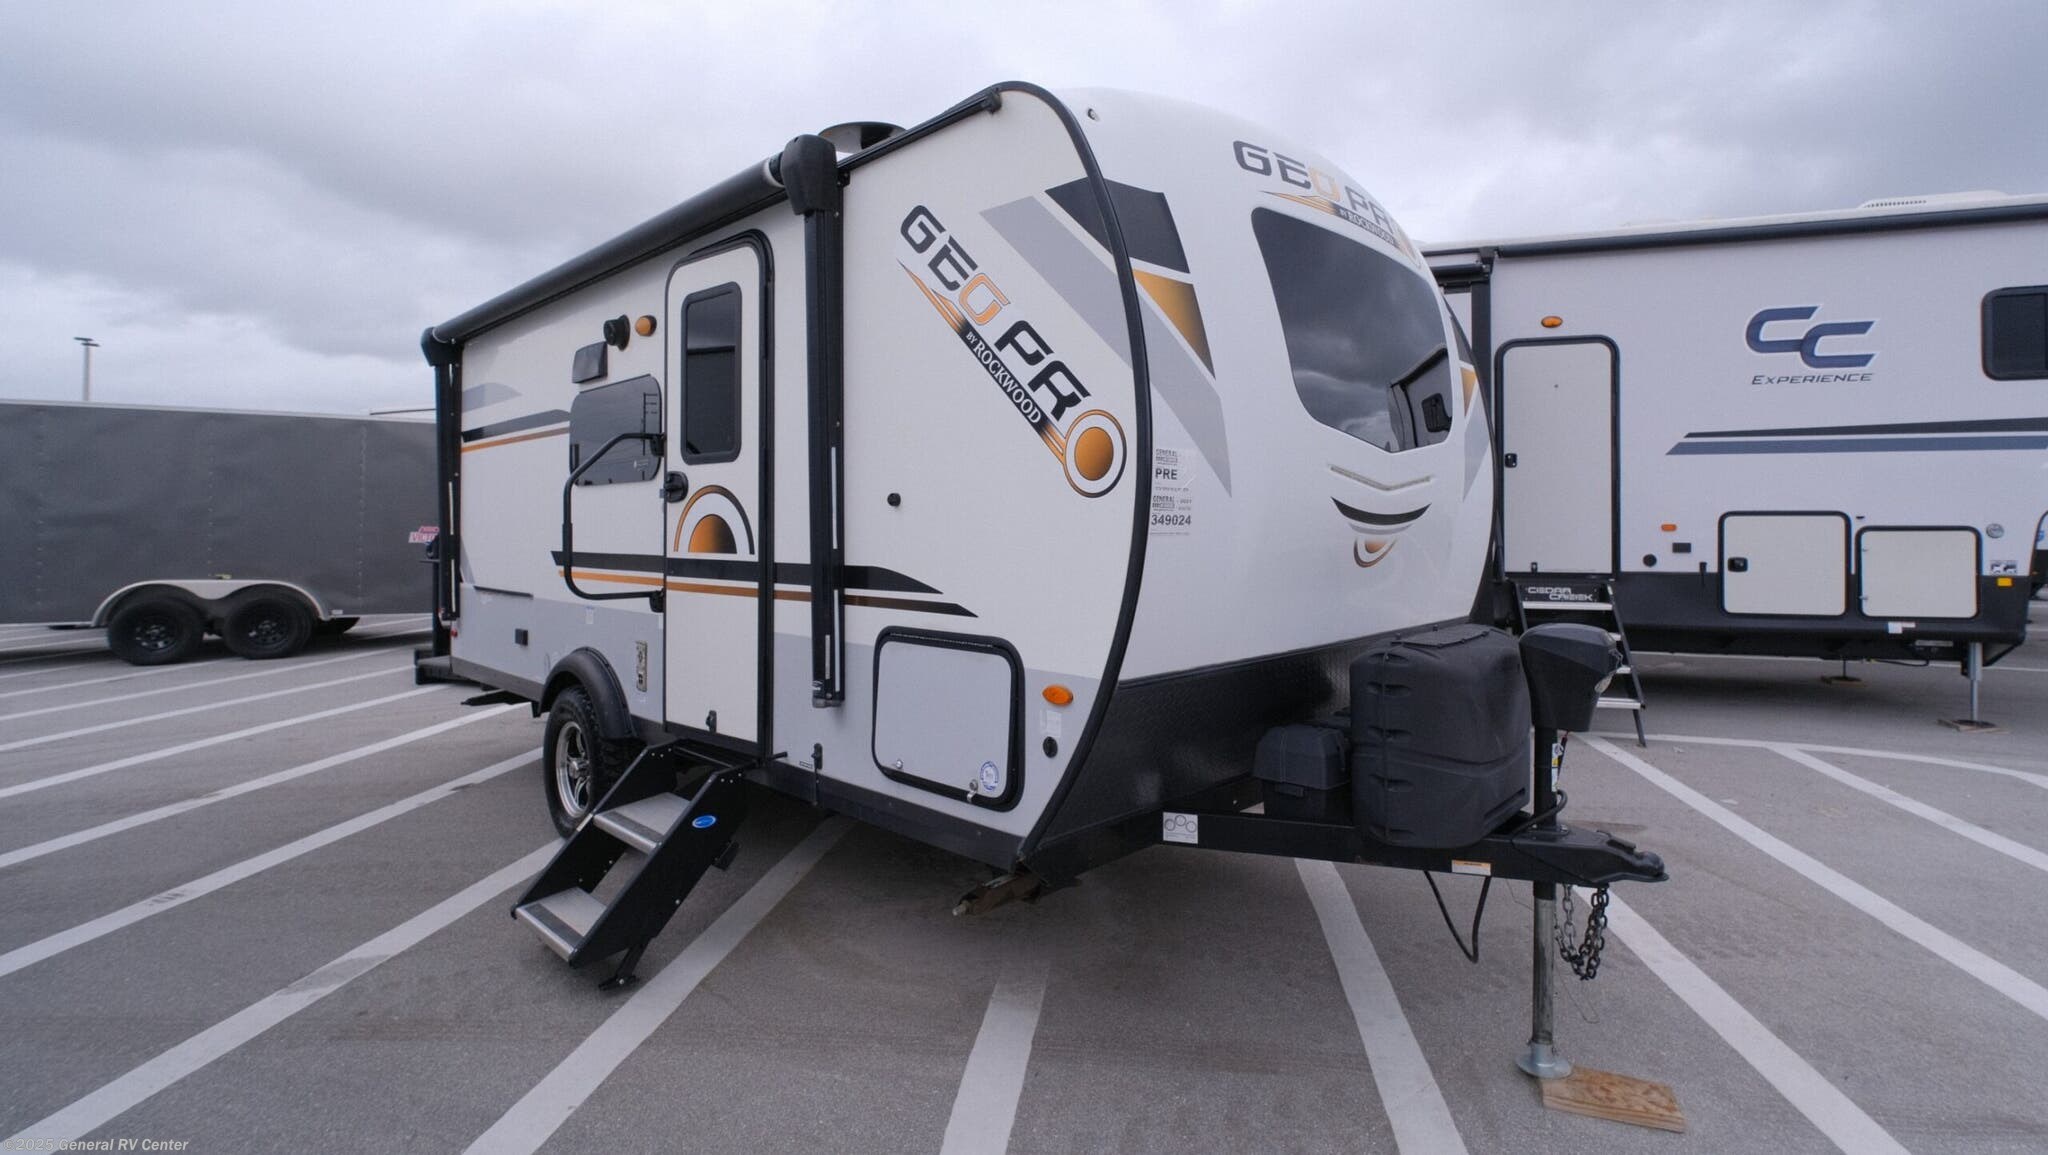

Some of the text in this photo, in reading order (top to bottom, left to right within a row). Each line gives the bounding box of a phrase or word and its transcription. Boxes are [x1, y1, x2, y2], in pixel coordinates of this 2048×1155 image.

[1233, 140, 1341, 202] GEO
[900, 204, 1011, 325] GEO
[1745, 305, 1876, 369] CC
[965, 331, 1041, 423] BY ROCKWOOD
[1155, 467, 1178, 480] PRE
[1151, 514, 1191, 526] 349024
[1527, 586, 1572, 595] CEDAR
